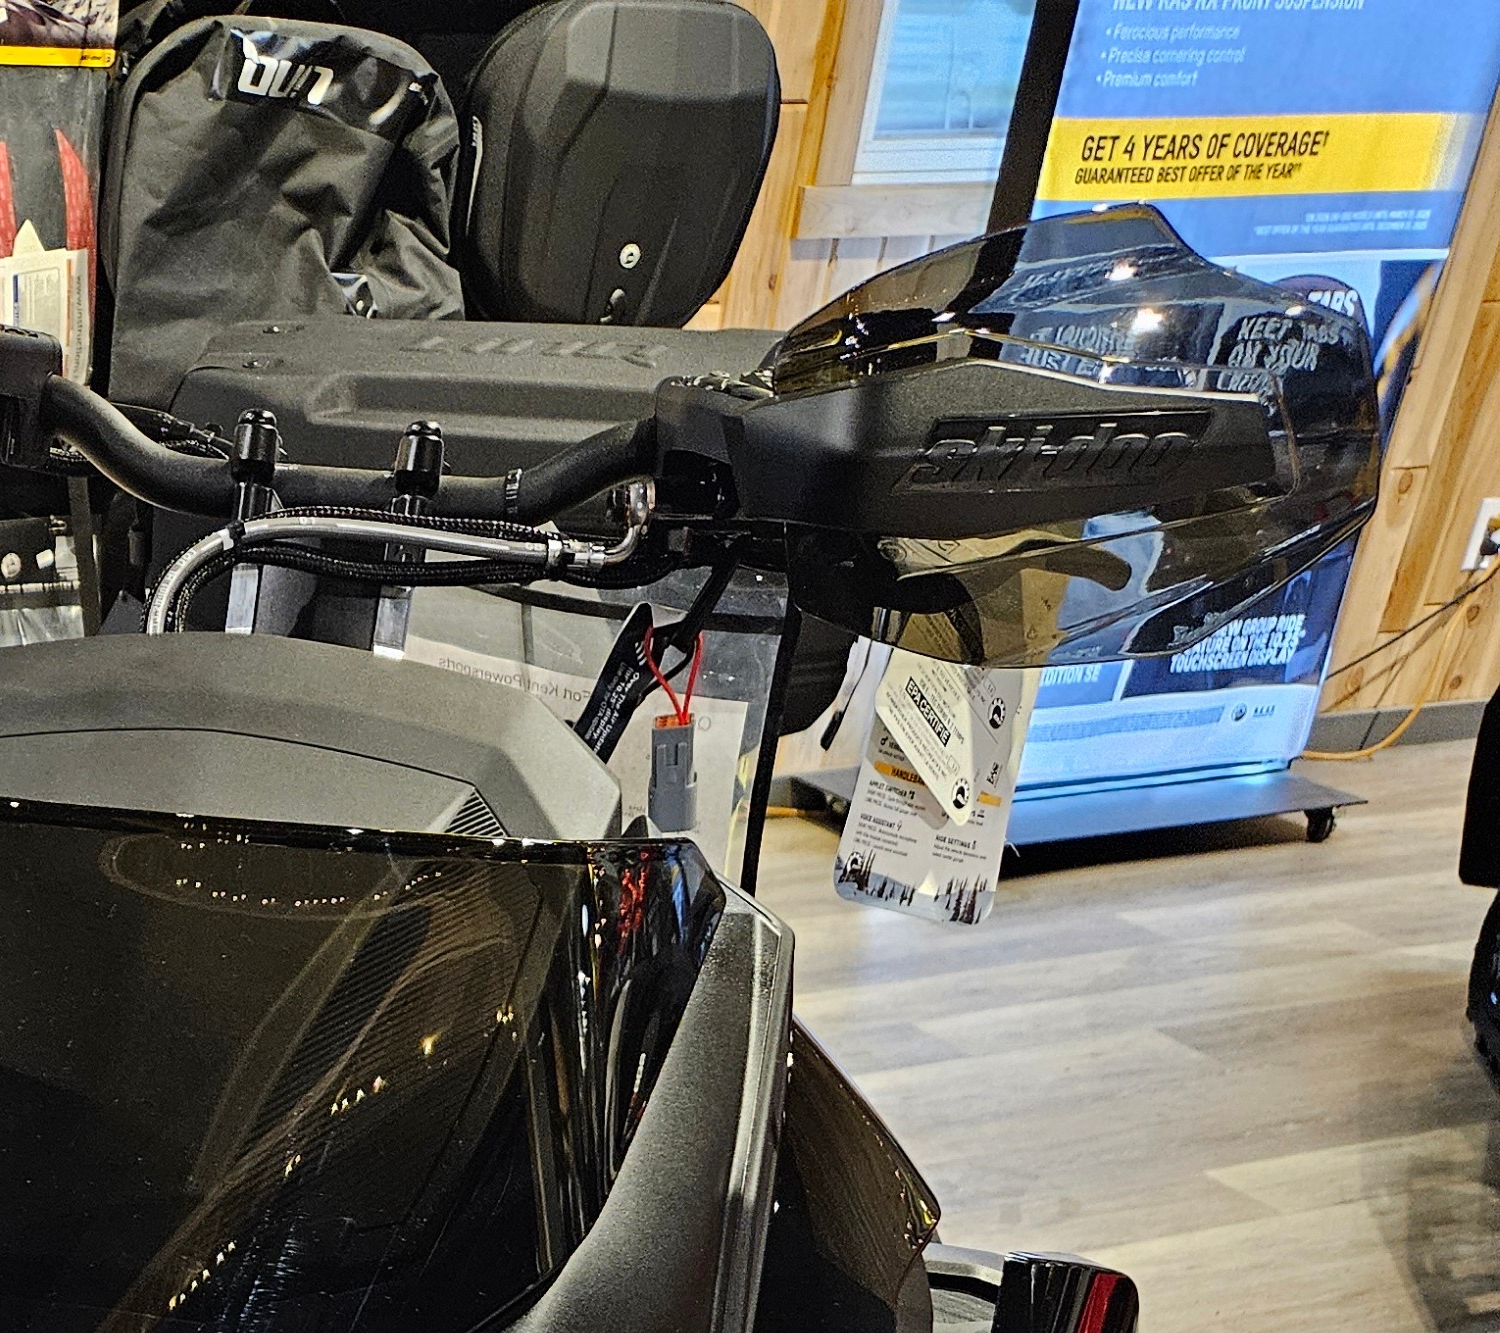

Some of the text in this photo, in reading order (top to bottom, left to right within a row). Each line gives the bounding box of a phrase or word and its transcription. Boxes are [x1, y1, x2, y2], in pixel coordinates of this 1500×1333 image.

[1108, 46, 1151, 63] Precise
[1102, 70, 1197, 87] Premium comfort
[1081, 135, 1120, 161] GET
[1123, 135, 1135, 161] 4
[1142, 134, 1203, 161] YEARS
[1206, 133, 1231, 160] OF
[1075, 167, 1154, 184] GUARANTEED
[1156, 166, 1187, 183] BEST
[1189, 165, 1225, 182] OFFER
[1226, 164, 1241, 181] OF
[1243, 163, 1264, 180] THE
[624, 672, 640, 693] Over
[616, 693, 626, 710] The
[907, 681, 925, 707] EPA
[611, 709, 619, 725] Air
